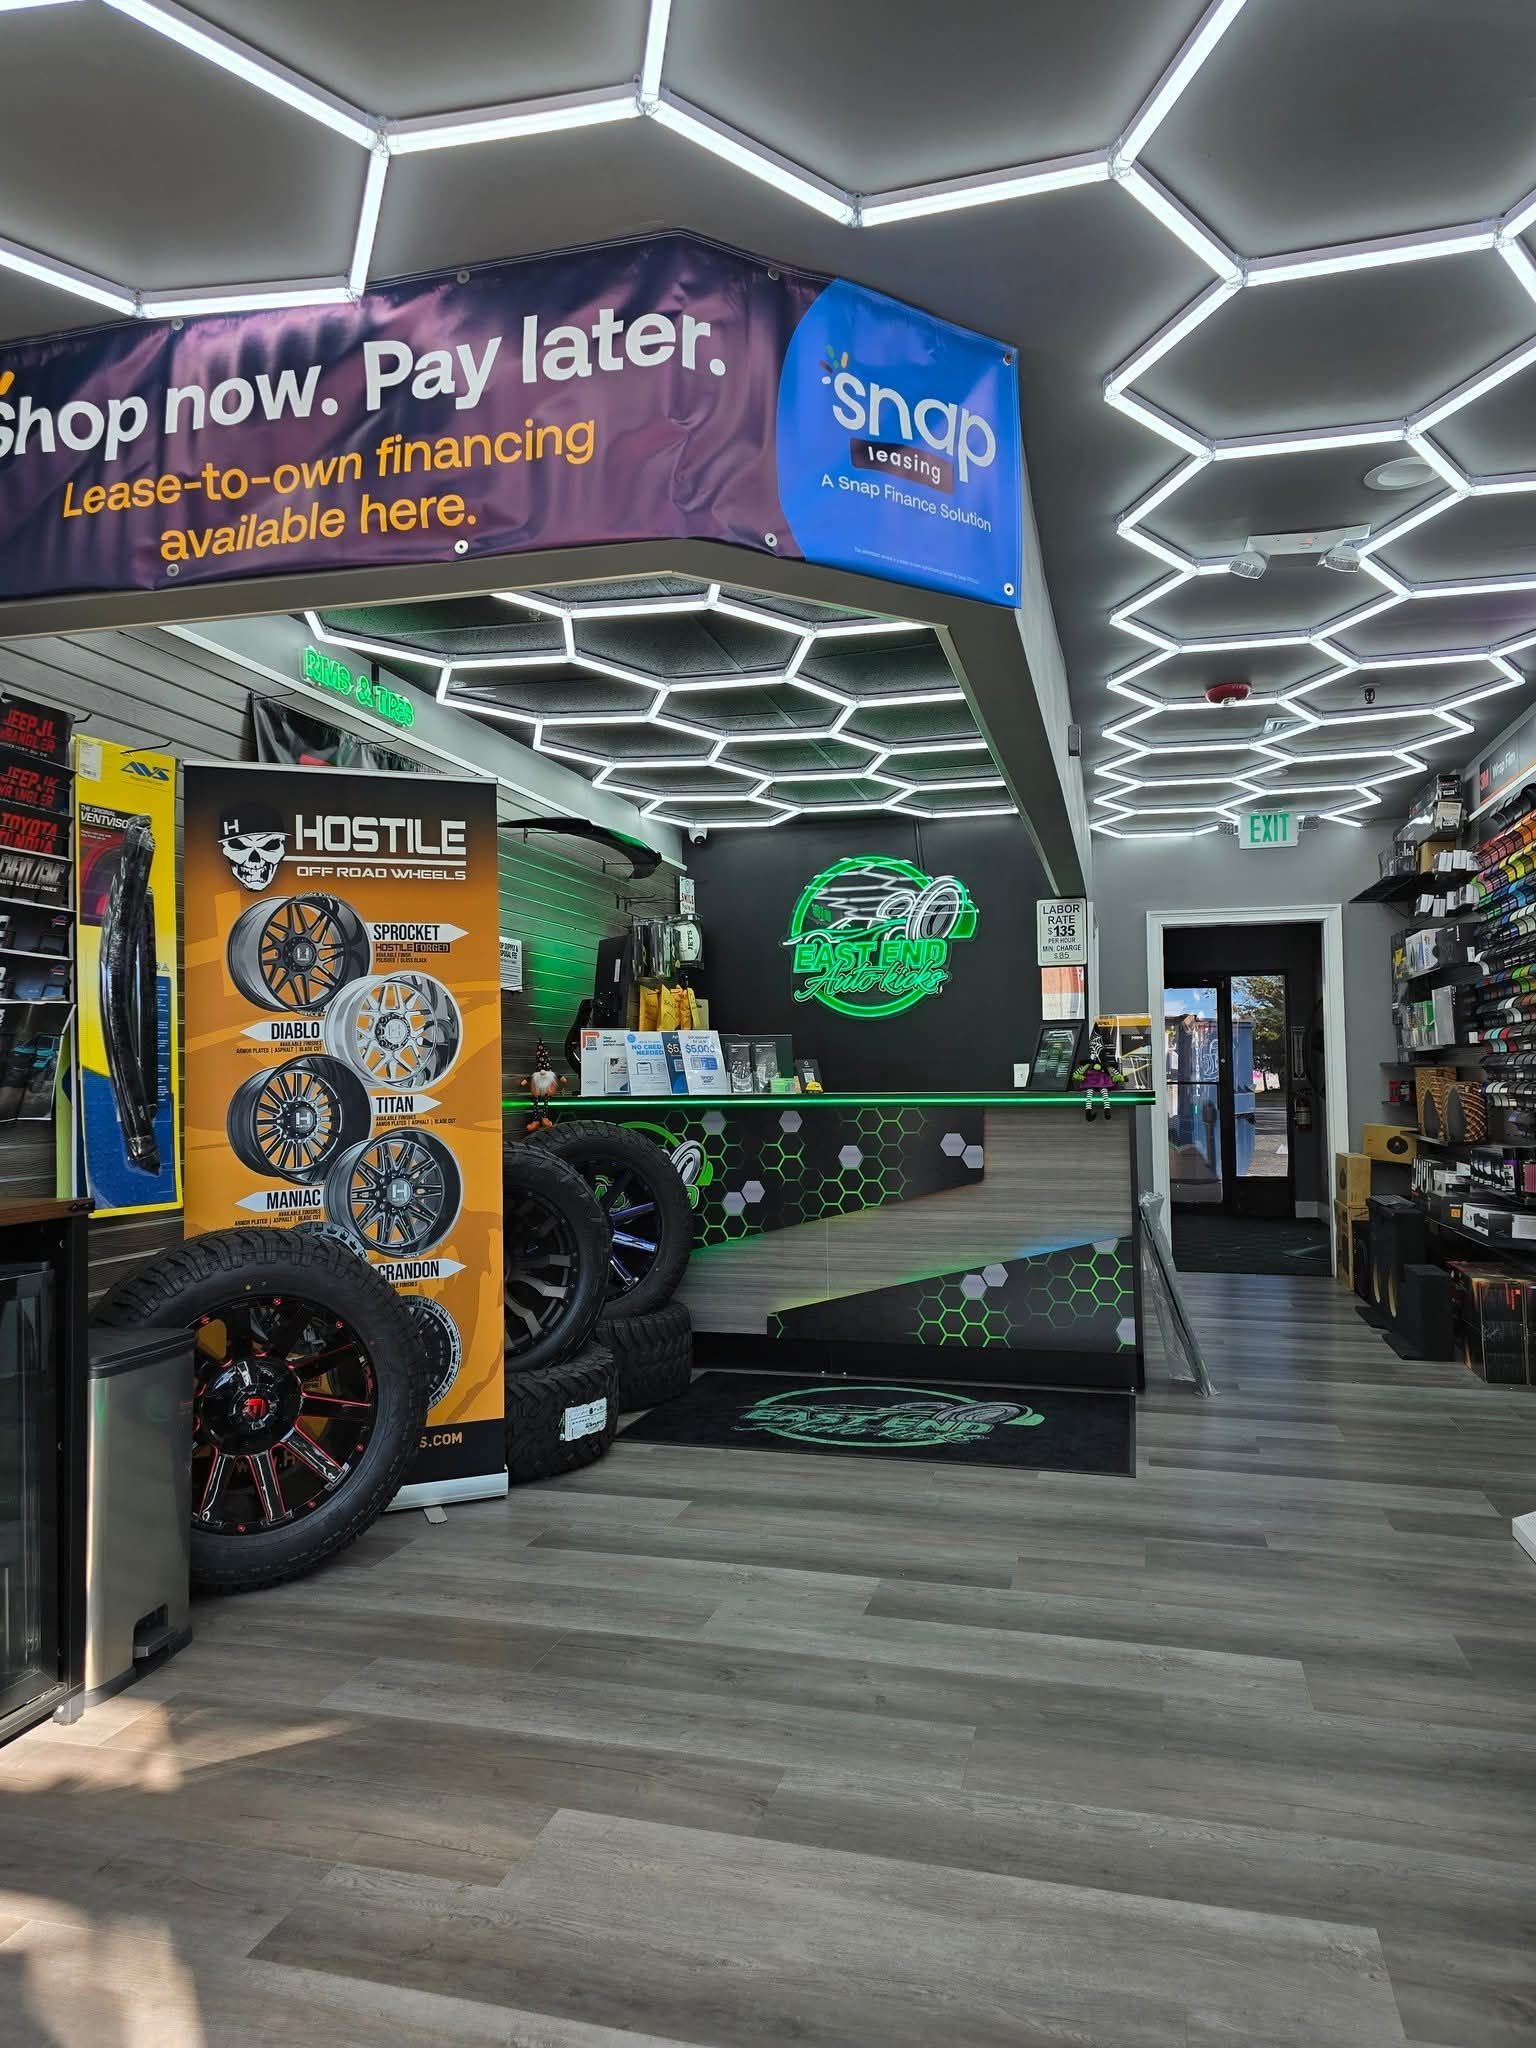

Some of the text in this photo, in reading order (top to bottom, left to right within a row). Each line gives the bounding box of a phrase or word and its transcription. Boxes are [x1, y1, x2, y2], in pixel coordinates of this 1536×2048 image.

[165, 365, 338, 435] now.
[363, 336, 502, 411] Pay
[521, 308, 728, 384] later.
[832, 371, 996, 483] snap
[62, 419, 596, 518] Lease-to-own financing
[867, 446, 942, 485] leasing
[821, 473, 992, 533] A Snap Finance Solution
[160, 491, 477, 563] available here.
[1, 812, 58, 836] TOYOTA
[80, 811, 129, 829] VENTVISO
[1250, 813, 1289, 843] EXIT
[295, 814, 467, 856] HOSTILE
[296, 866, 467, 881] OFF ROAD WHEELS
[1042, 904, 1080, 914] LABOR
[1047, 914, 1076, 924] RATE
[373, 924, 440, 940] SPROCKET
[1047, 925, 1076, 937] $135
[375, 943, 449, 952] HOSTILE FORGED
[793, 937, 949, 973] EAST END
[794, 960, 885, 1002] Auto
[271, 1022, 320, 1040] DIABLO
[376, 1096, 414, 1113] TITAN
[266, 1189, 321, 1209] MANIAC
[378, 1261, 440, 1280] CRANDON
